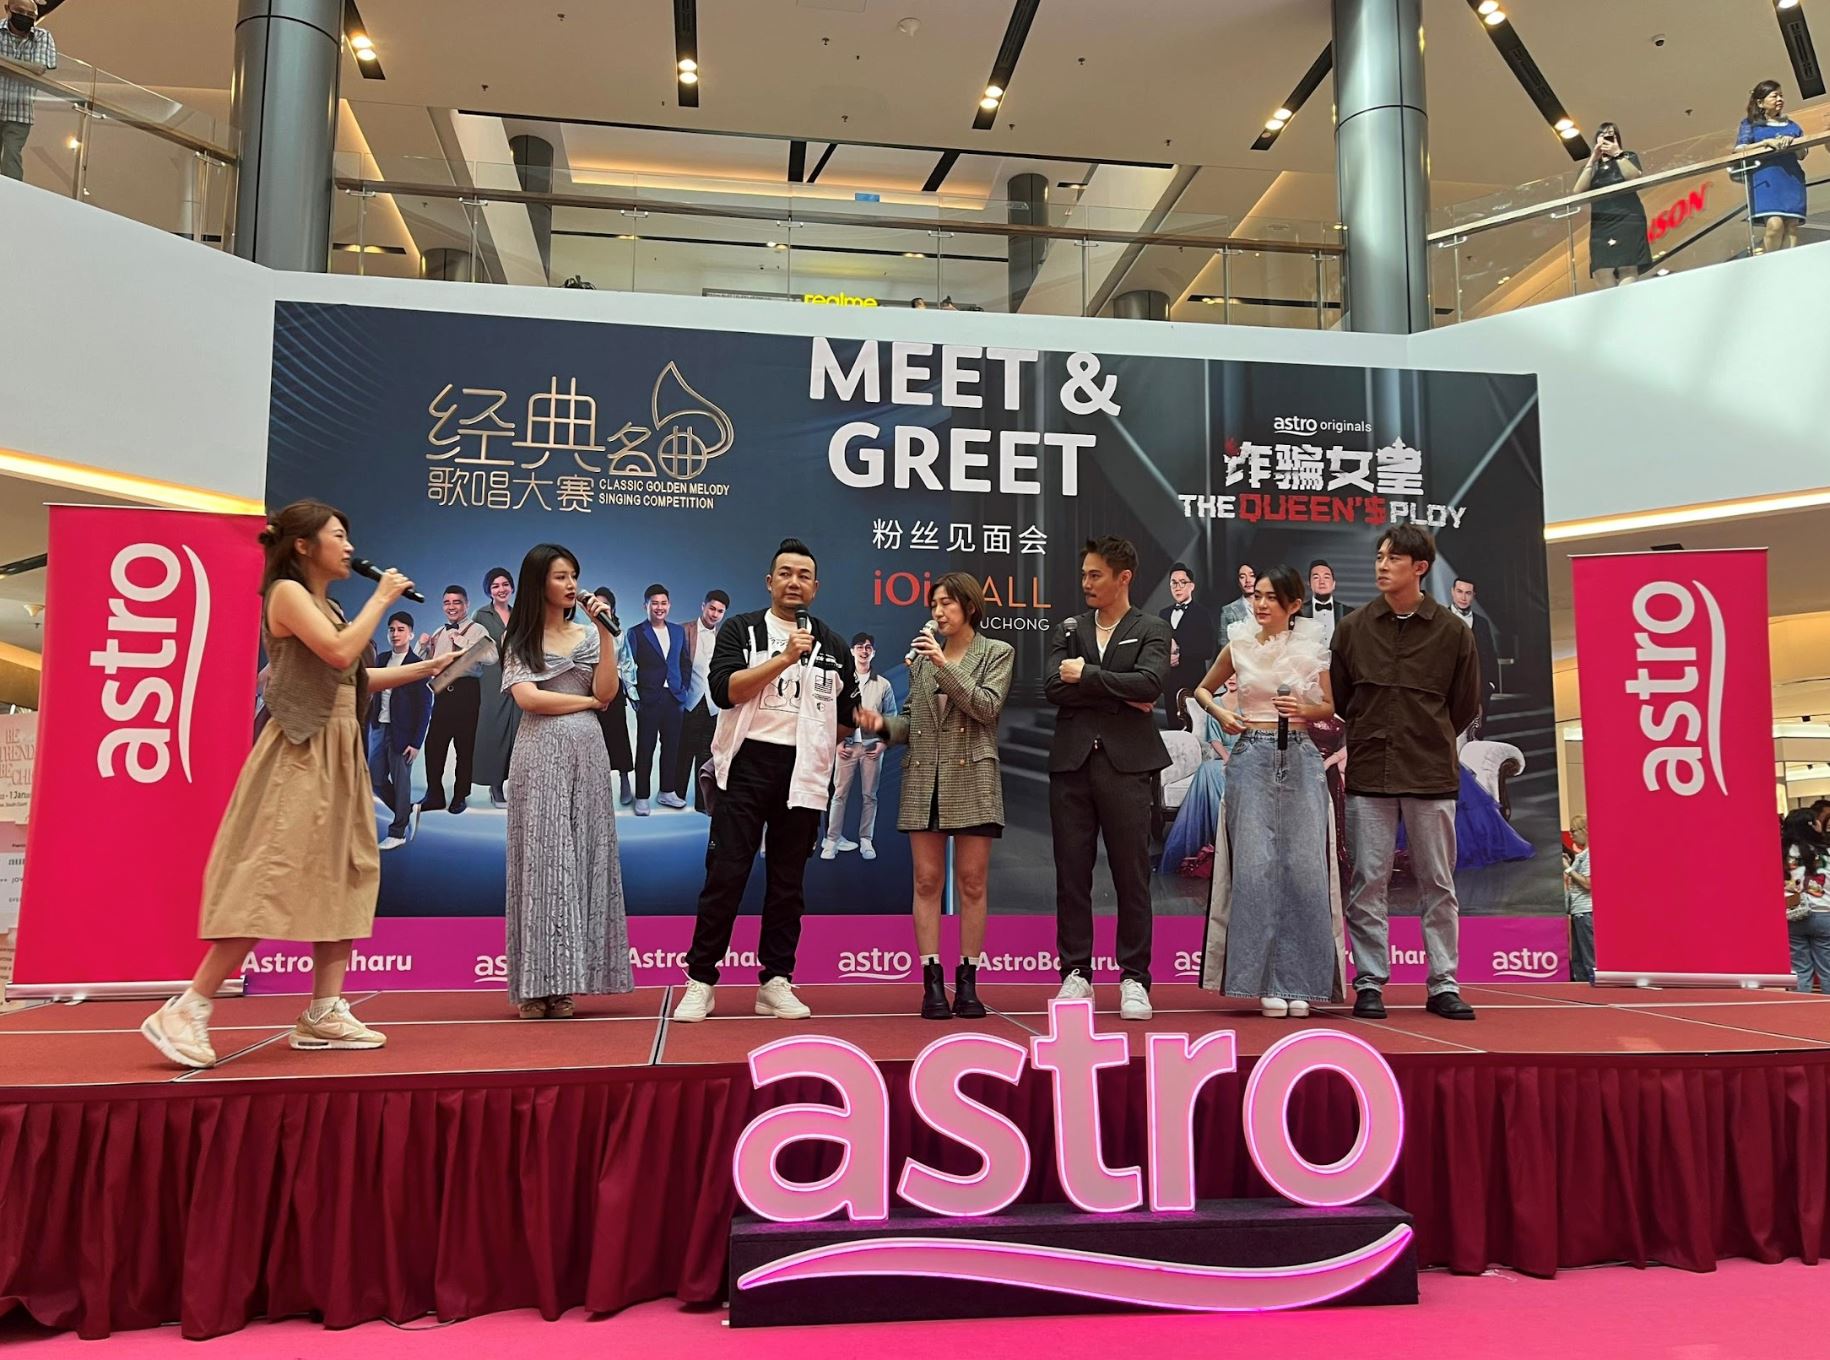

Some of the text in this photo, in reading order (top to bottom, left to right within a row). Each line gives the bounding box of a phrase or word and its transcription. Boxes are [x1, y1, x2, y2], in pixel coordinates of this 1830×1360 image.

[804, 292, 878, 308] realme
[810, 336, 1122, 417] MEET &
[1273, 416, 1372, 434] astro originals
[828, 421, 1096, 497] GREET
[1223, 436, 1425, 496] 诈骗女皇
[427, 466, 595, 513] 歌唱大赛
[598, 493, 714, 508] SINGING COMPETITION
[599, 478, 730, 496] CLASSIC GOLDEN MELODY
[1178, 494, 1236, 519] THE
[1390, 500, 1467, 529] PLOY
[872, 518, 1048, 555] 粉丝见面会
[980, 575, 1052, 609] ALL
[979, 616, 1051, 631] UCHONG
[90, 541, 183, 785] astro
[1625, 580, 1705, 797] astro
[240, 949, 412, 973] Astroharu
[837, 947, 912, 972] astro
[976, 951, 1121, 972] AstroBaru
[1492, 948, 1558, 970] astro
[732, 997, 1406, 1223] astro
